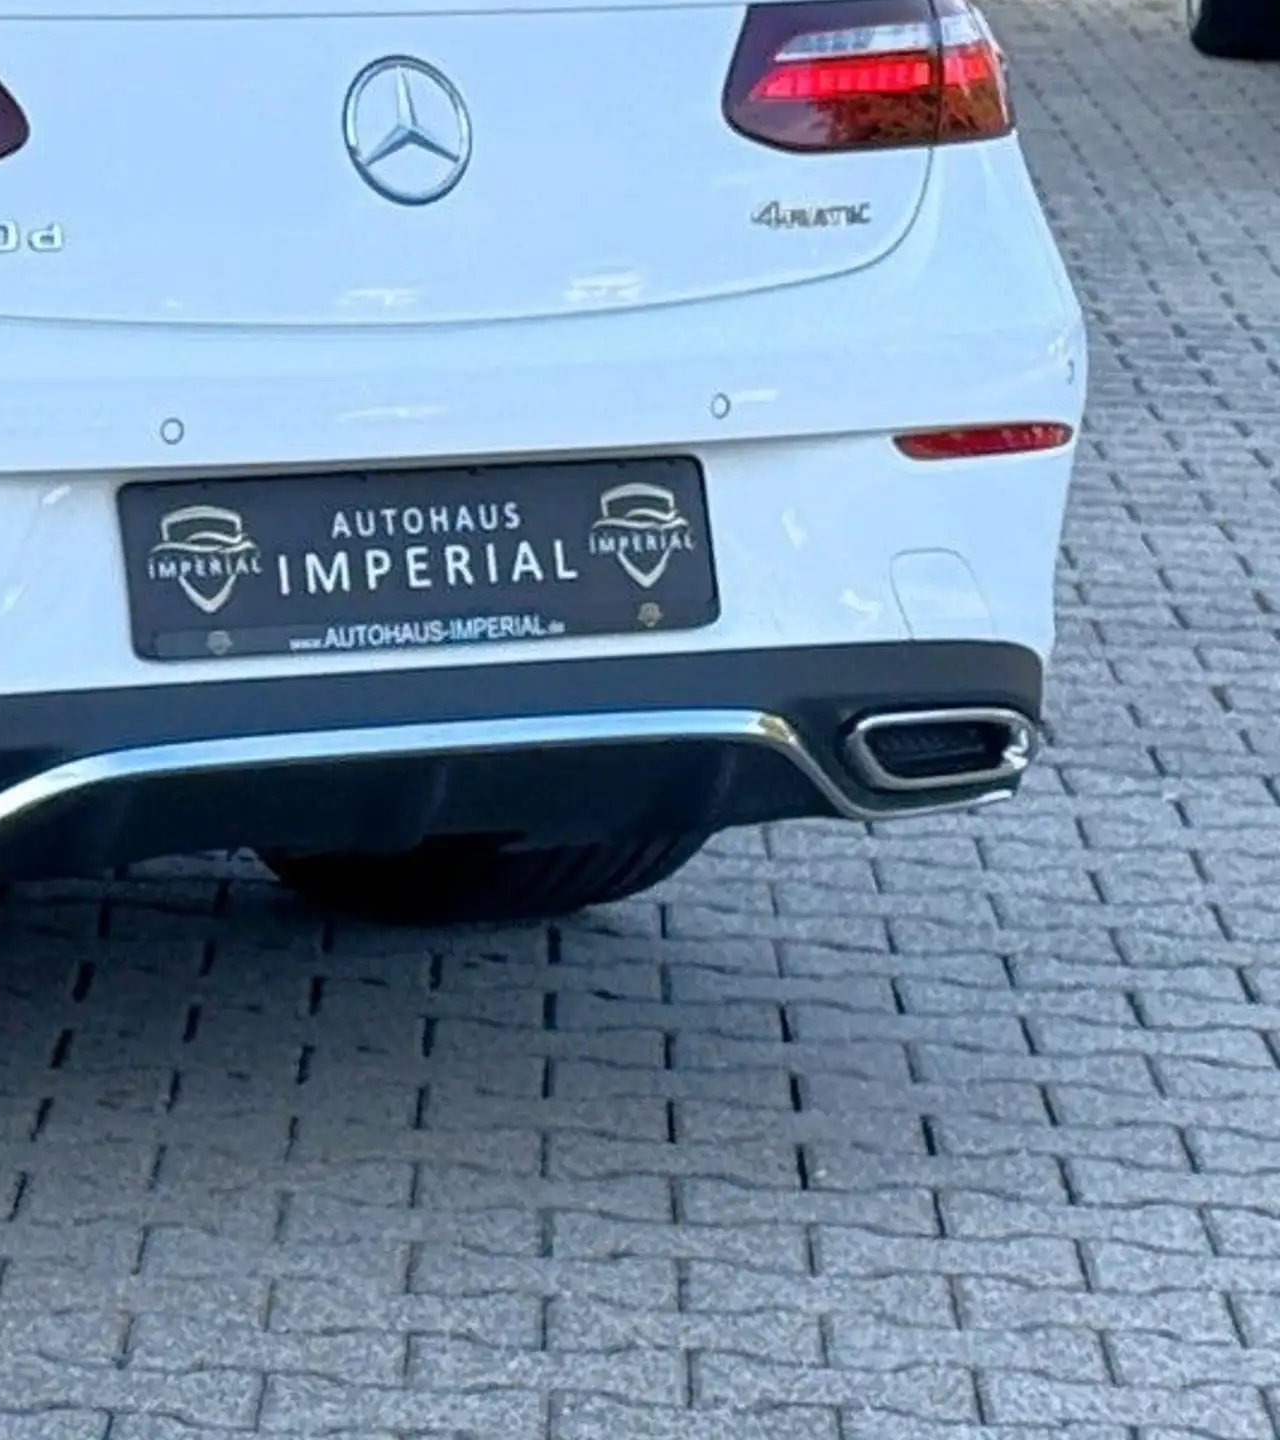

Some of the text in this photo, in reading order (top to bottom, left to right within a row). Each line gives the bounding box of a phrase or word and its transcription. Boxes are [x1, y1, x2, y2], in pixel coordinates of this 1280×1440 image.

[331, 501, 521, 539] AUTOHAUS
[589, 529, 697, 555] IMPERIAL
[147, 552, 263, 581] IMPERIAL
[278, 538, 579, 596] IMPERIAL
